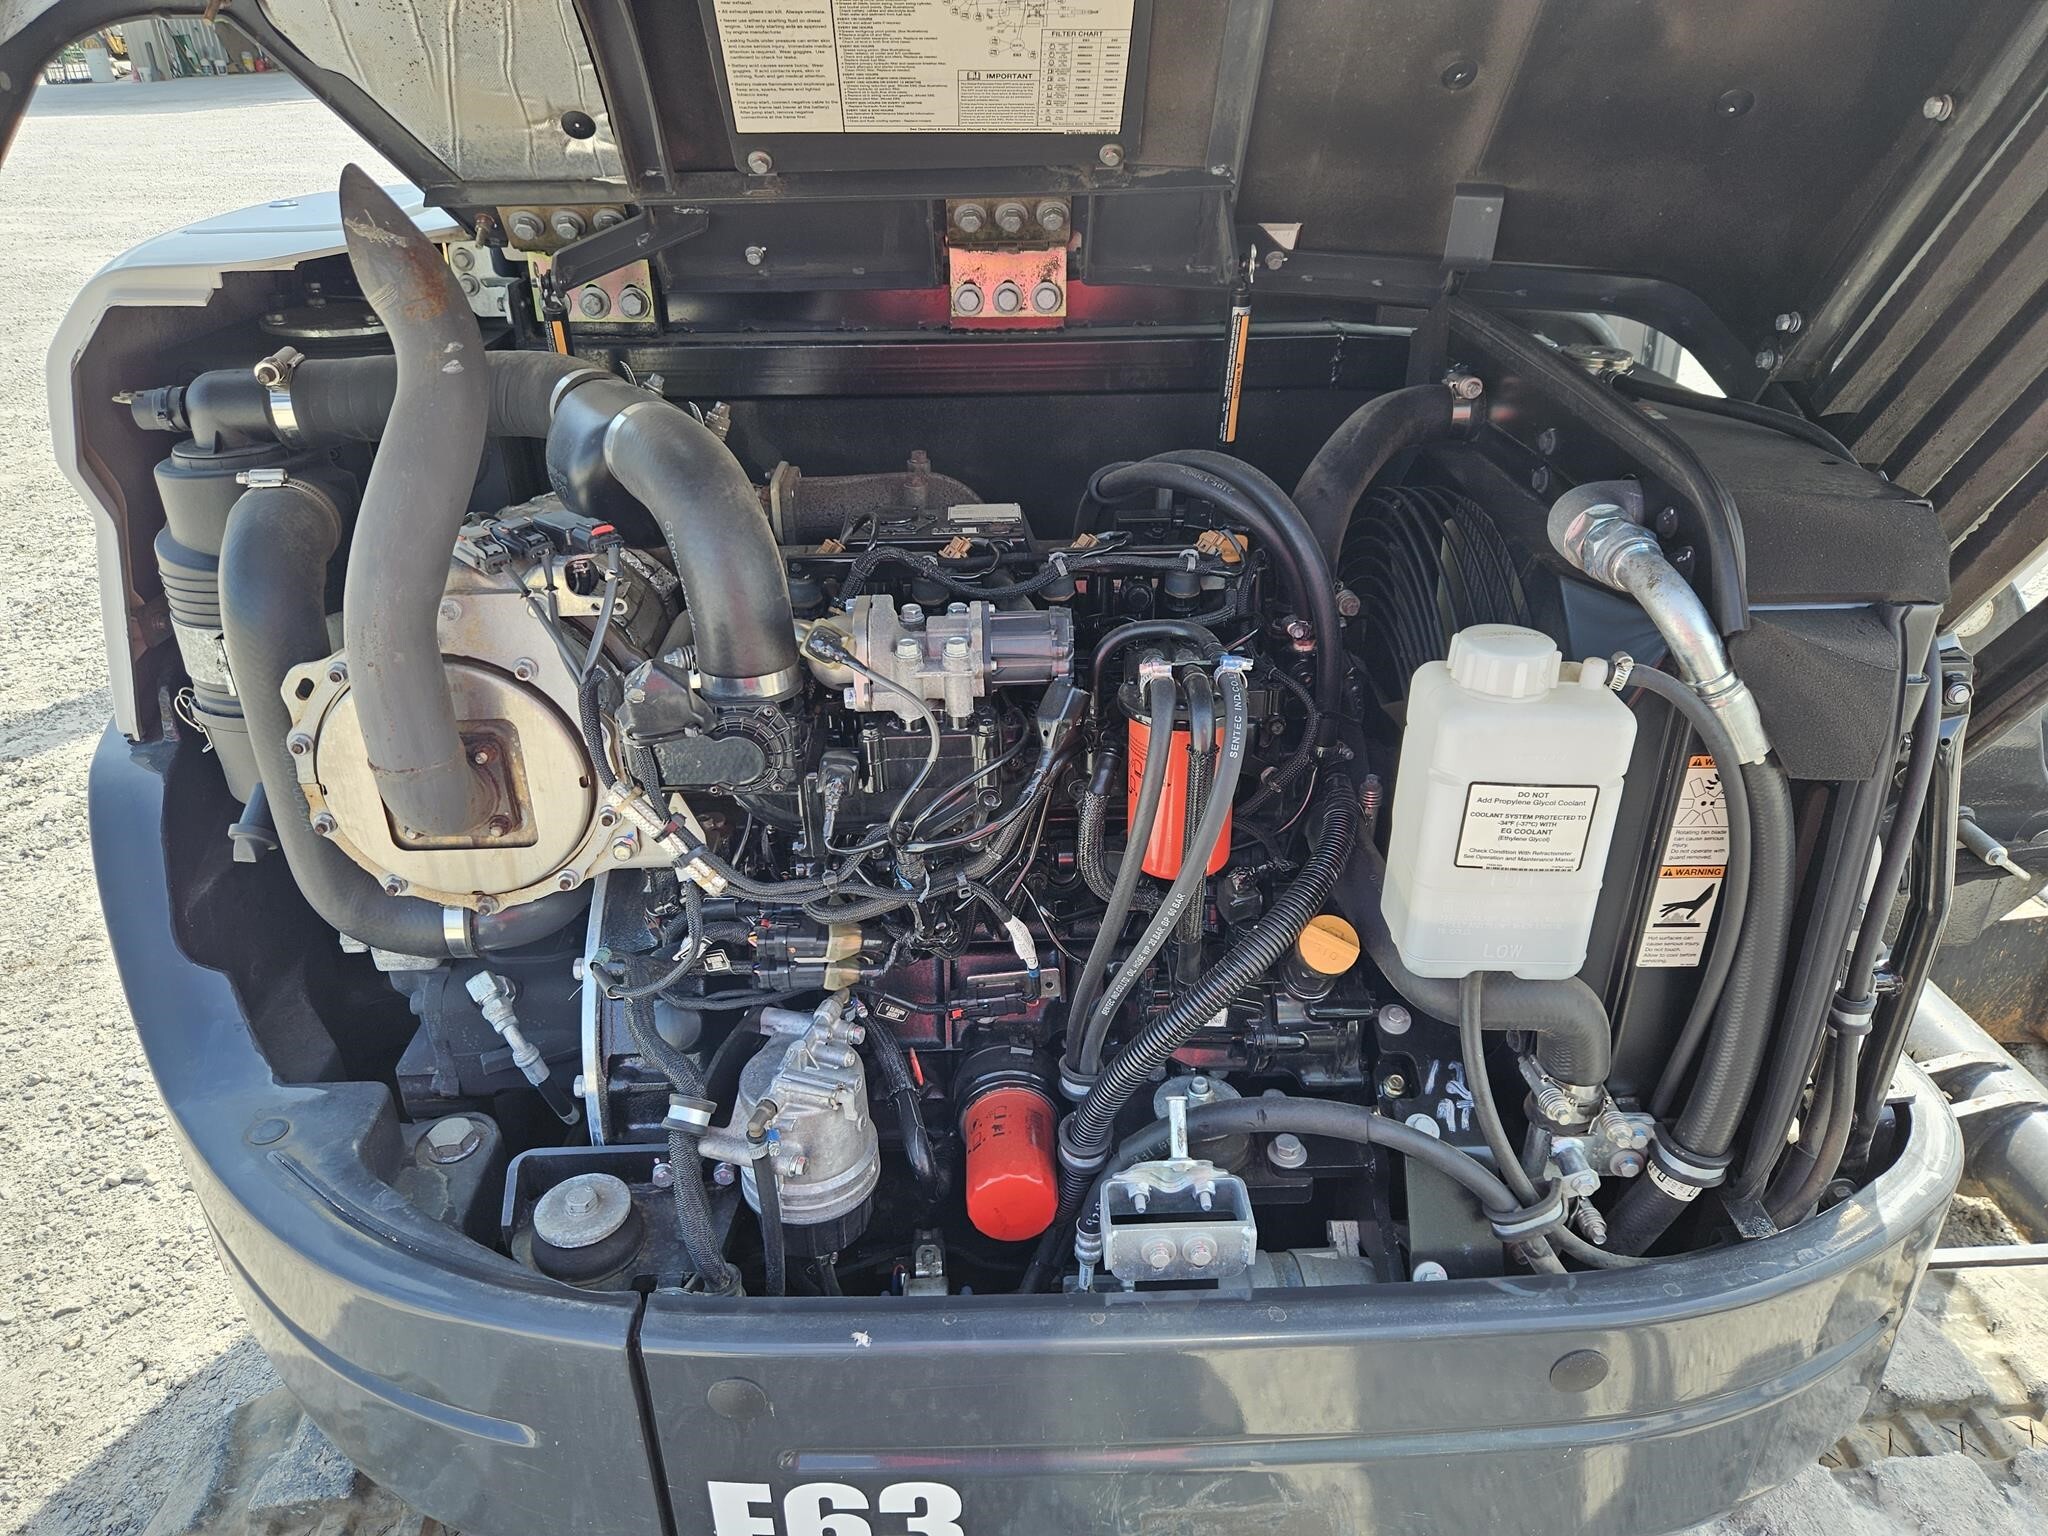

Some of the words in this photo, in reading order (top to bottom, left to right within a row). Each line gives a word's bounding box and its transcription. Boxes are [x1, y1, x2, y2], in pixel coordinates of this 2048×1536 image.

[1230, 715, 1242, 759] SENTEC
[1494, 798, 1531, 806] Propylene
[1675, 868, 1721, 876] WARNING
[1172, 893, 1186, 909] BAR
[1168, 907, 1177, 917] 60
[1152, 926, 1166, 943] BAR
[1482, 943, 1524, 959] LOW
[1134, 953, 1146, 970] HOSE
[1127, 965, 1137, 977] OIL
[1101, 997, 1116, 1016] SENTEC
